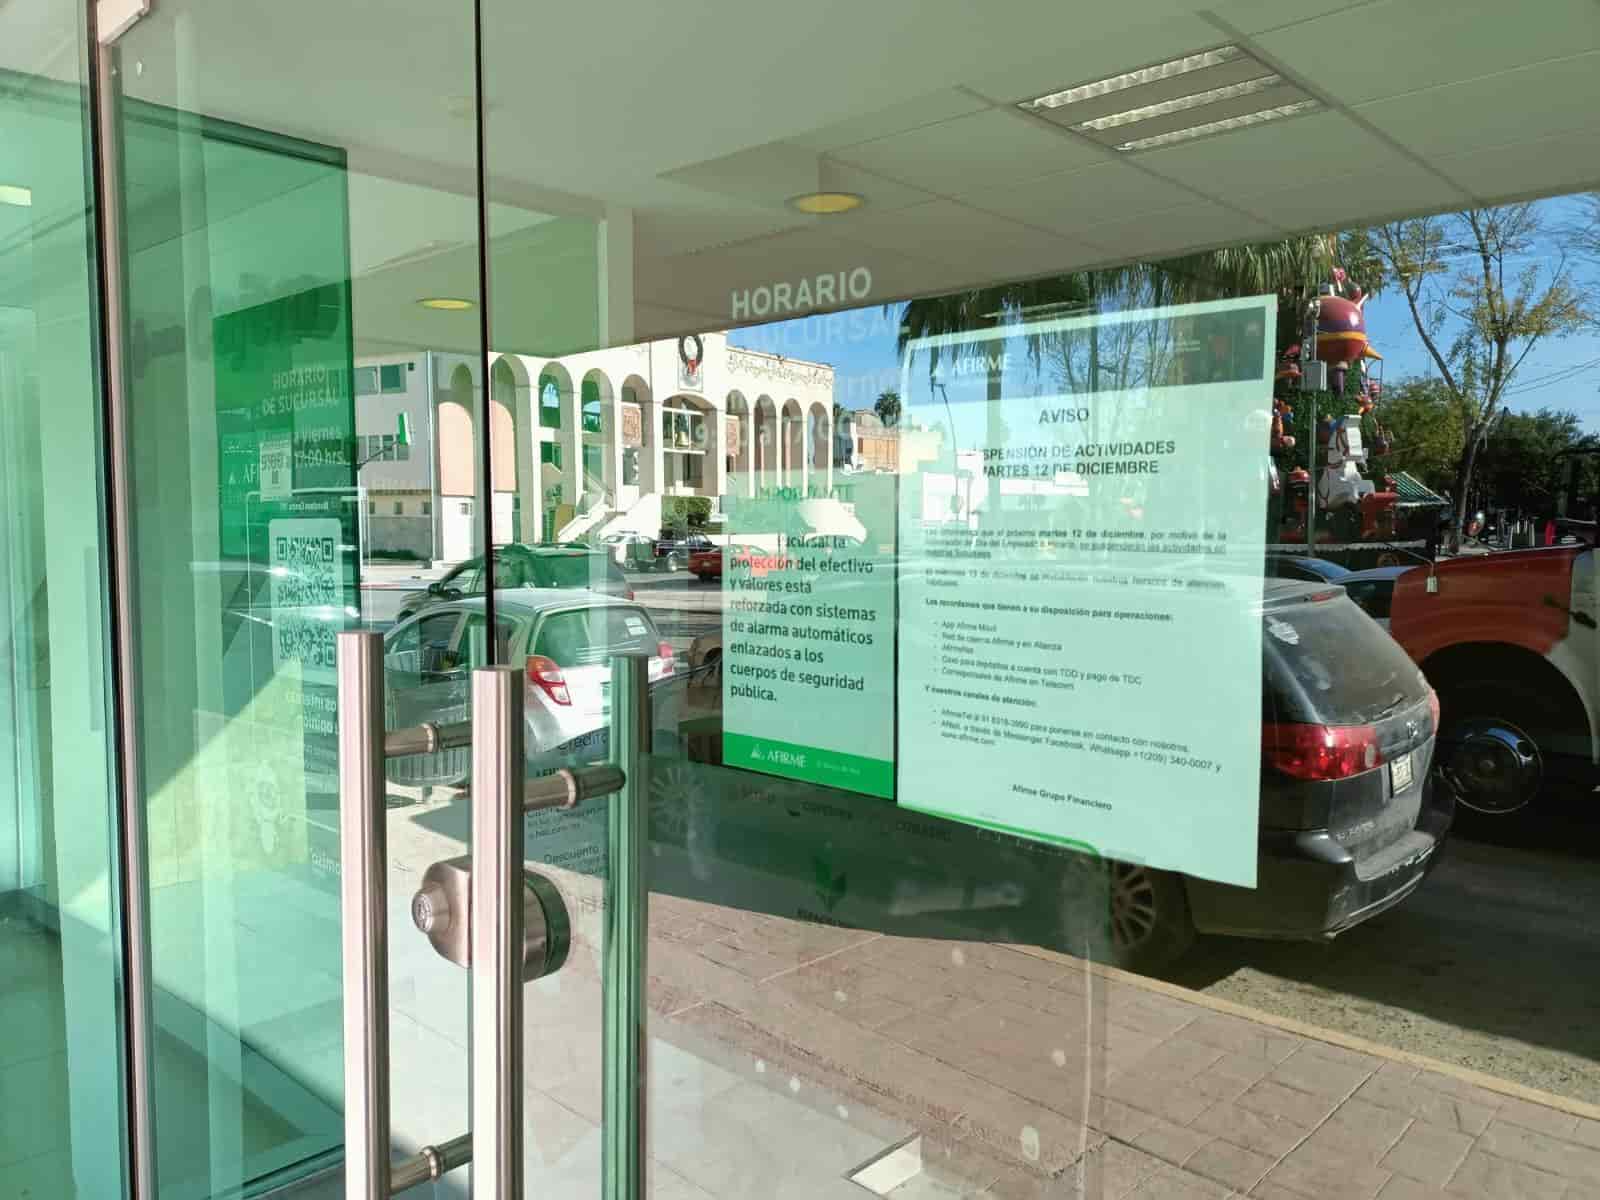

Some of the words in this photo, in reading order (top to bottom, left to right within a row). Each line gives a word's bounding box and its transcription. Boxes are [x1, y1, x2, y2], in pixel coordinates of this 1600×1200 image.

[731, 266, 873, 321] HORARIO
[952, 354, 1010, 374] AFIRME
[272, 366, 326, 391] HORARIO
[262, 396, 276, 415] DE
[1038, 407, 1089, 425] AVISO
[974, 446, 1048, 462] SPENSIÓN
[1052, 445, 1072, 459] DE
[1075, 440, 1176, 459] ACTIVIDADES
[1034, 463, 1049, 476] 12
[1052, 462, 1072, 475] DE
[1075, 460, 1160, 475] DICIEMBRE
[781, 534, 829, 550] ucursal
[1038, 529, 1067, 538] martes
[1072, 529, 1082, 538] 12
[1086, 530, 1097, 538] de
[1150, 531, 1163, 541] por
[1202, 532, 1214, 540] de
[729, 554, 792, 570] protección
[797, 556, 816, 572] del
[820, 557, 874, 574] efectivo
[729, 577, 738, 590] y
[738, 577, 783, 592] valores
[785, 579, 812, 594] está
[729, 598, 787, 616] reforzada
[790, 604, 813, 617] con
[816, 603, 876, 622] sistemas
[1040, 605, 1090, 617] disposición
[1092, 608, 1112, 619] para
[729, 619, 745, 633] de
[747, 620, 789, 637] alarma
[792, 624, 874, 645] automáticos
[729, 641, 792, 661] enlazados
[794, 650, 801, 661] a
[804, 648, 824, 664] los
[729, 663, 777, 681] cuerpos
[780, 668, 796, 683] de
[799, 671, 865, 693] seguridad
[1087, 672, 1107, 683] pago
[1108, 674, 1120, 683] de
[991, 693, 1001, 702] de
[1082, 730, 1093, 739] en
[1095, 732, 1130, 745] contacto
[1132, 737, 1148, 747] con
[767, 749, 808, 769] AFIRME
[1215, 764, 1222, 774] y
[1012, 783, 1037, 797] Afirme
[1040, 789, 1065, 803] Grupo
[1067, 793, 1113, 811] Financiero
[543, 843, 600, 865] Descuento
